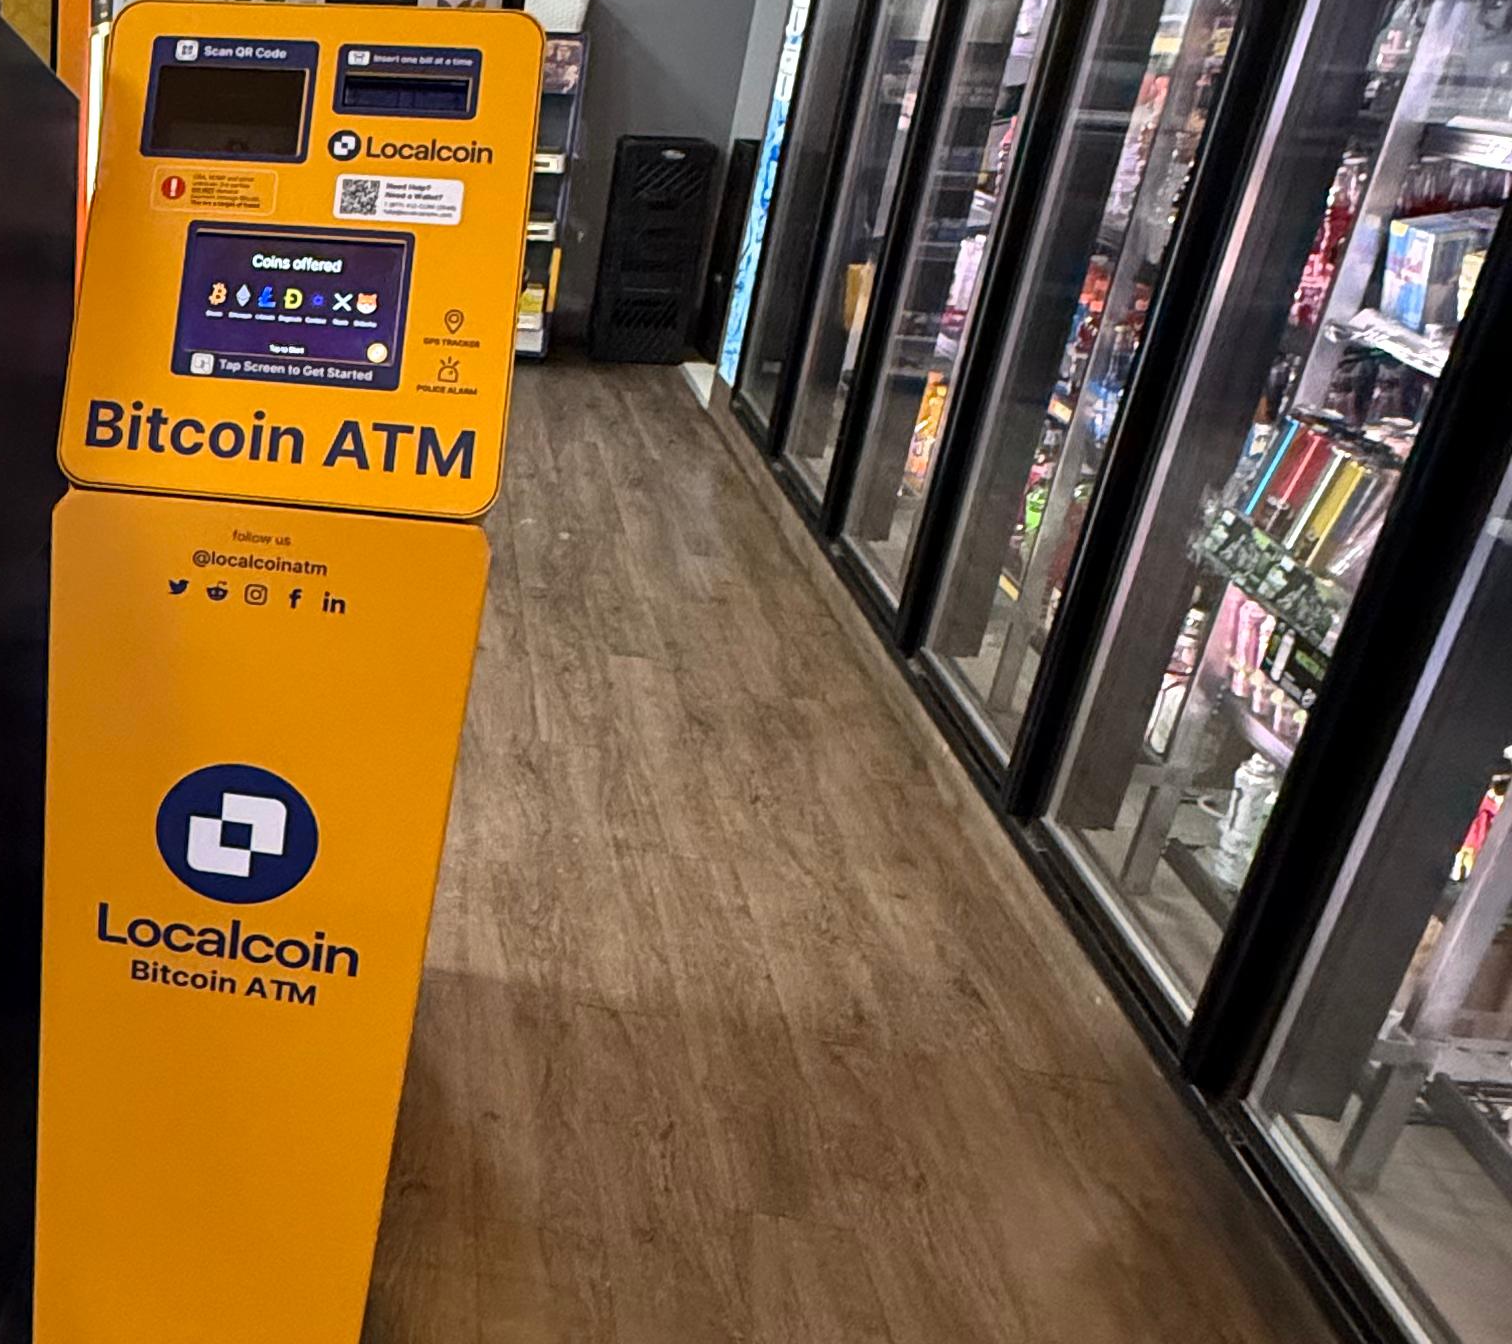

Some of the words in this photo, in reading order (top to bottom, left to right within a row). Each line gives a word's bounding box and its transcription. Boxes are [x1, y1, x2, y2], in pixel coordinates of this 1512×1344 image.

[203, 45, 233, 58] Scan
[235, 46, 254, 59] QR
[255, 47, 287, 60] Code
[373, 53, 399, 64] Insert
[418, 54, 434, 65] bill
[434, 56, 444, 66] at
[452, 56, 473, 67] time
[365, 135, 494, 164] Localcoin
[251, 253, 291, 271] Coins
[292, 254, 342, 274] offered
[423, 337, 440, 346] GPS
[442, 338, 481, 348] TRACKER
[219, 358, 242, 373] Tap
[243, 360, 286, 375] Screen
[287, 362, 300, 375] to
[302, 365, 325, 378] Get
[326, 366, 374, 382] Started
[416, 384, 446, 394] POLICE
[85, 399, 305, 465] Bitcoin
[322, 419, 477, 480] ATM
[232, 529, 273, 546] follow
[275, 534, 292, 547] us
[192, 549, 328, 577] @localcoinatm
[96, 901, 361, 978] Localcoin
[130, 959, 237, 994] Bitcoin
[244, 978, 317, 1007] ATM
